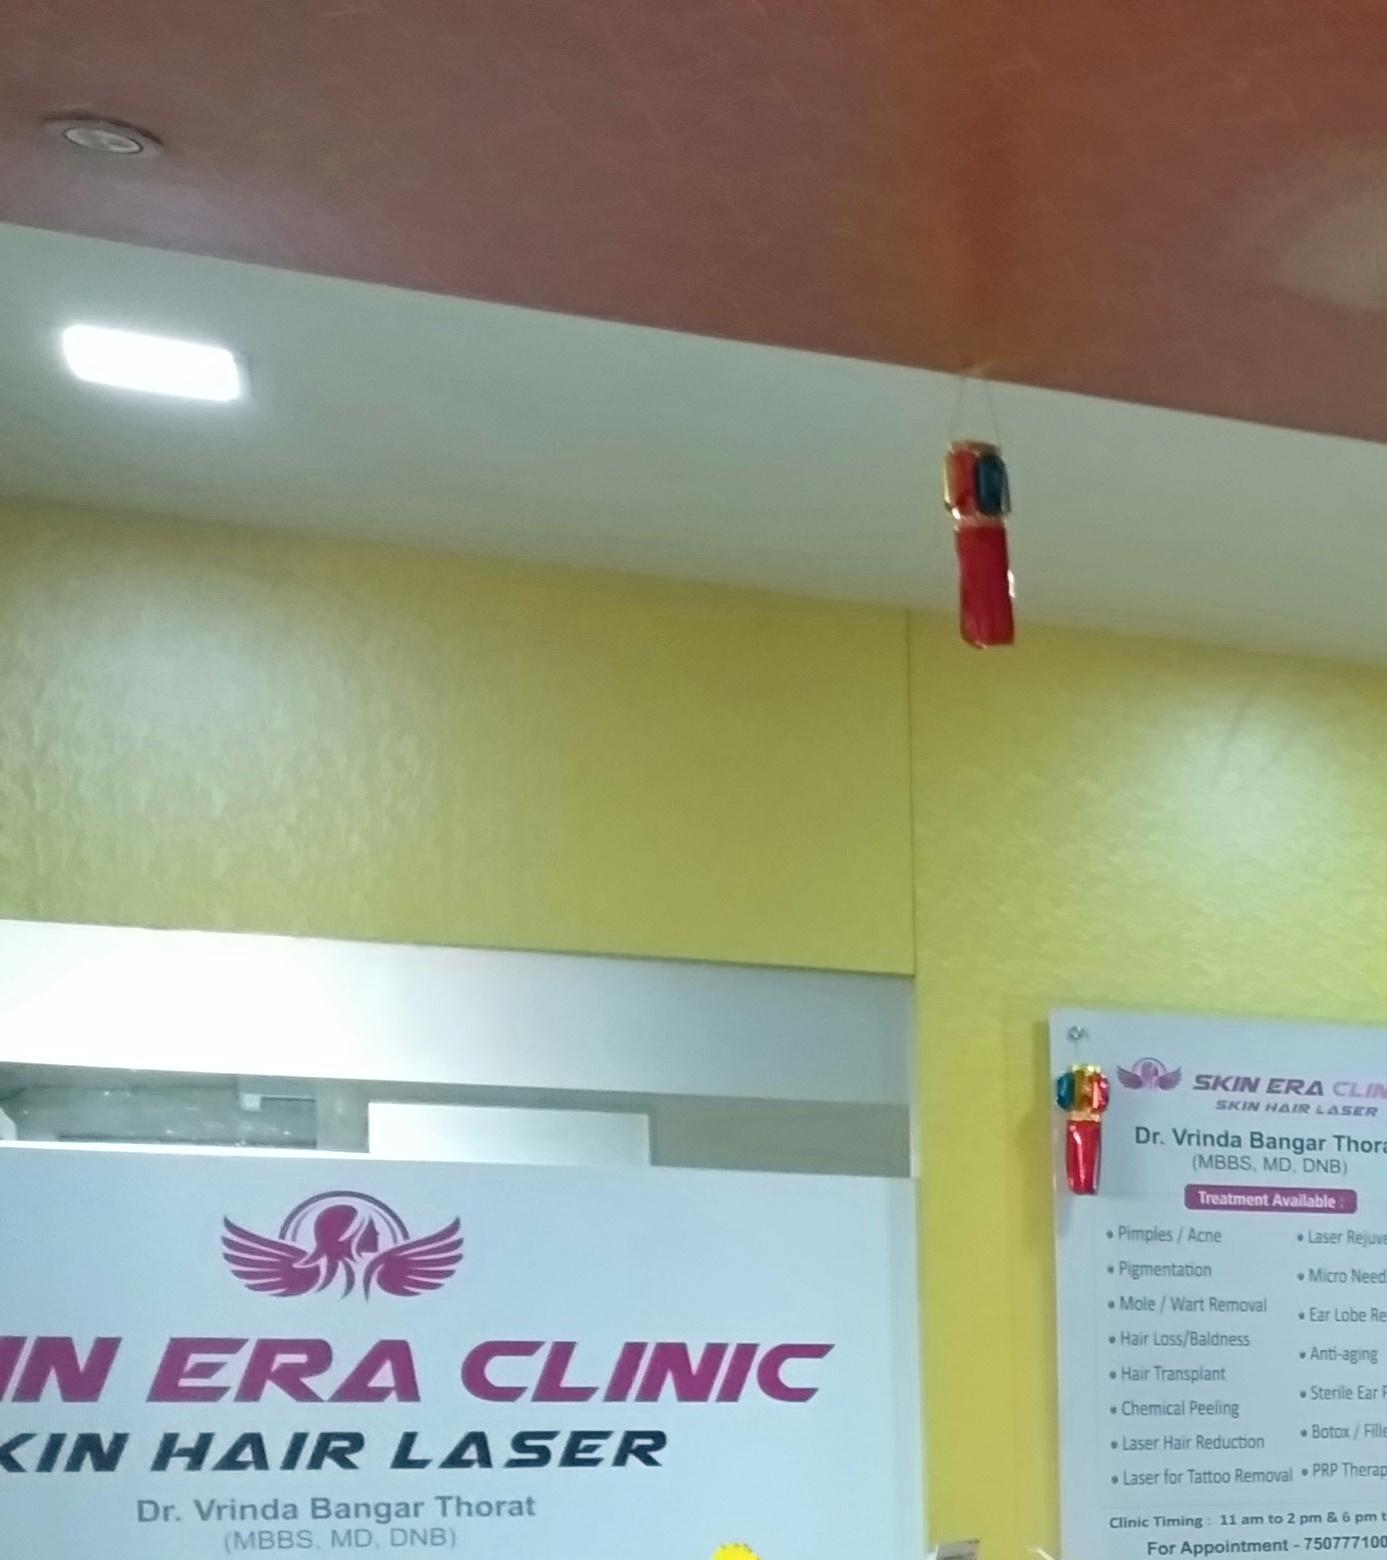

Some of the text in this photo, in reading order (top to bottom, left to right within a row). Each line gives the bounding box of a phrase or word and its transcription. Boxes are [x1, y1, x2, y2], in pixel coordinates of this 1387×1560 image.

[1193, 1074, 1260, 1094] SKIN
[1266, 1079, 1323, 1095] ERA
[1215, 1100, 1378, 1117] SKIN HAIR LASER
[1135, 1127, 1165, 1144] Dr.
[1172, 1128, 1242, 1148] Vrinda
[1250, 1131, 1326, 1154] Bangar
[1303, 1159, 1347, 1175] DNB)
[1198, 1190, 1336, 1209] Treatment Available
[1308, 1231, 1343, 1245] Laser
[1119, 1261, 1212, 1280] Pigmentation
[1309, 1269, 1347, 1284] Micro
[1310, 1308, 1330, 1322] Ear
[1335, 1308, 1366, 1322] Lobe
[1121, 1331, 1250, 1348] Hair Loss/Baldness
[1311, 1346, 1377, 1364] Anti-aging
[146, 1337, 421, 1402] ERA
[460, 1341, 836, 1402] CLINIC
[1121, 1366, 1225, 1384] Hair Transplant
[1311, 1385, 1353, 1399] Sterile
[1358, 1386, 1378, 1399] Ear
[1121, 1401, 1239, 1419] Chemical Peeling
[150, 1431, 369, 1471] HAIR
[390, 1429, 668, 1469] LASER
[1312, 1463, 1337, 1477] PRP
[137, 1494, 535, 1525] Dr. Vrinda Bangar Thorat
[330, 1525, 379, 1550] MD,
[390, 1523, 457, 1550] DNB)
[1147, 1541, 1175, 1556] For
[1180, 1539, 1289, 1556] Appointment
